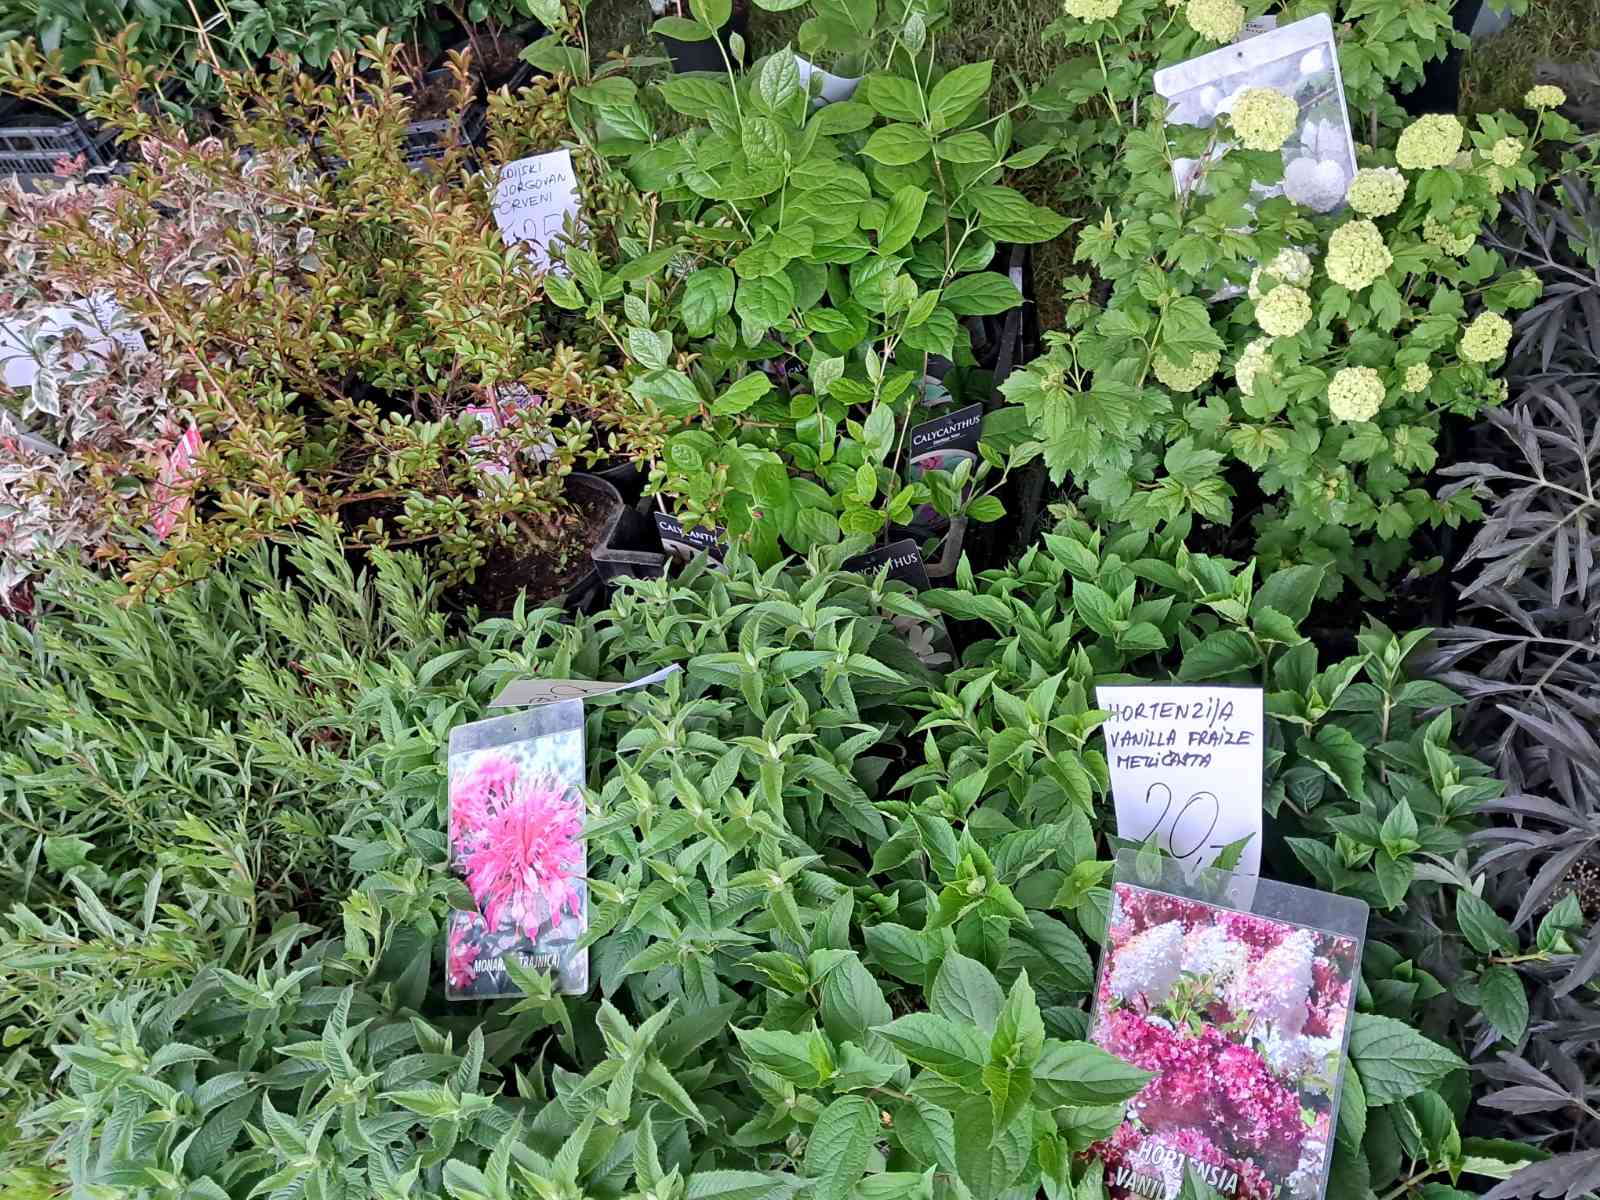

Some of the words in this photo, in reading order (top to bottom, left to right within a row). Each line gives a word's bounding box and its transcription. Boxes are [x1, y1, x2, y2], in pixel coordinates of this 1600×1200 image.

[502, 173, 566, 197] JORGOVAN
[499, 191, 553, 215] CRVENI
[913, 415, 981, 446] CALYCANTHUS
[1137, 1139, 1239, 1195] HORTNSIA
